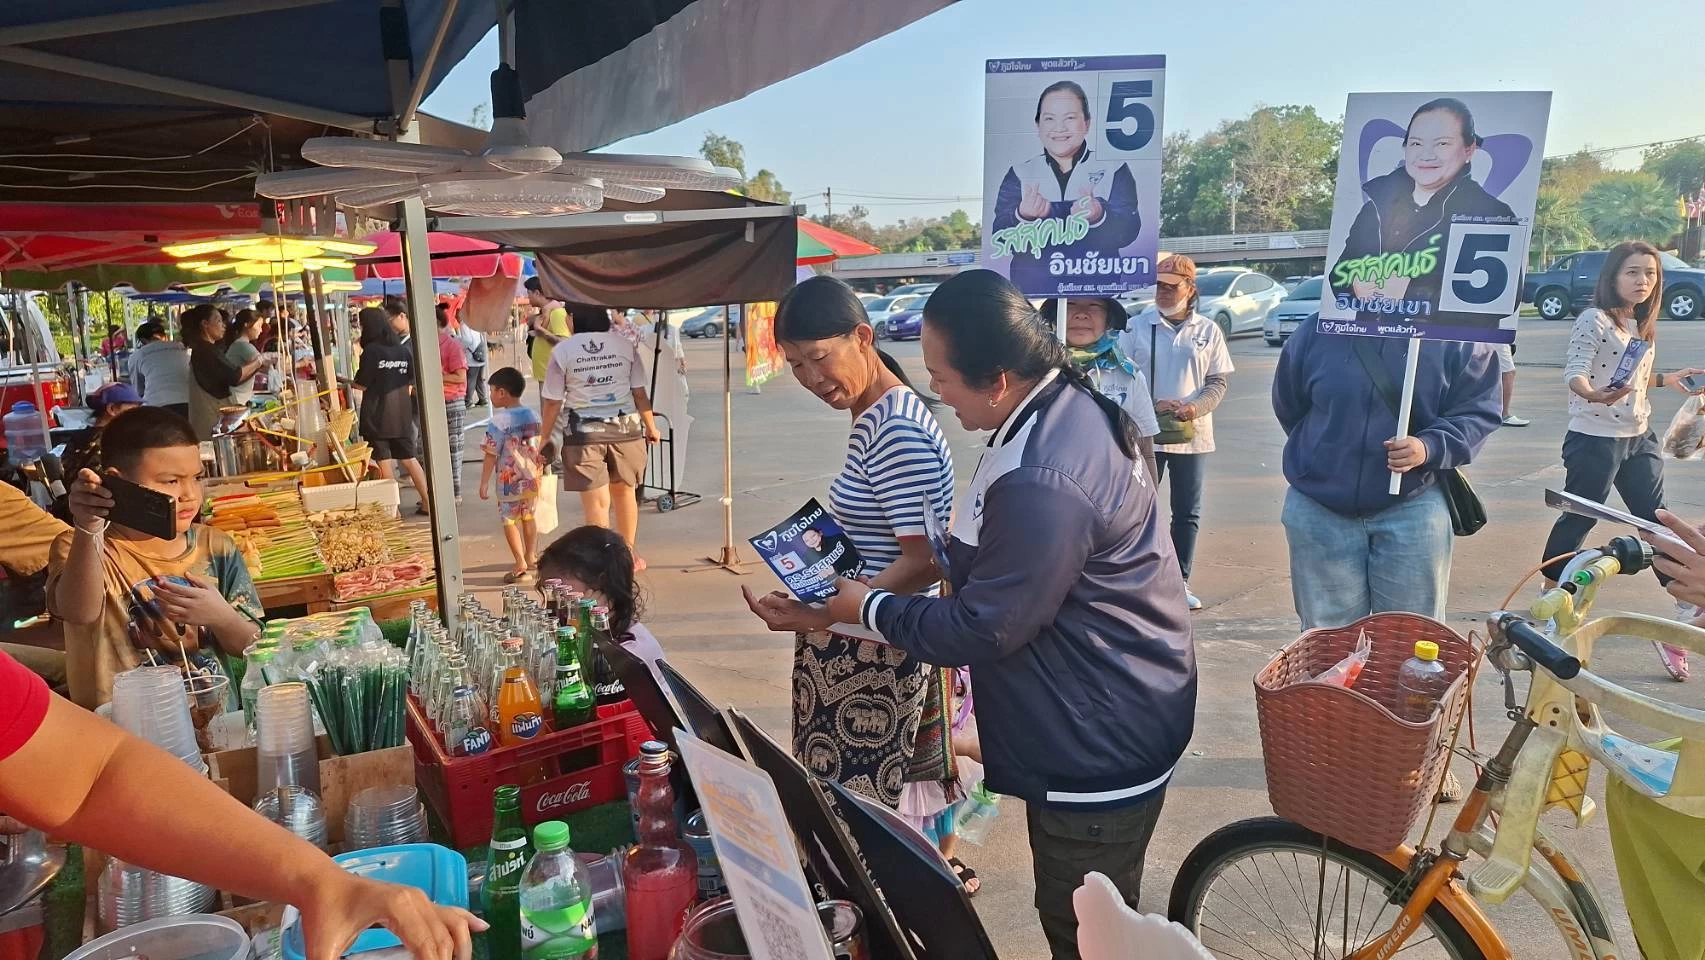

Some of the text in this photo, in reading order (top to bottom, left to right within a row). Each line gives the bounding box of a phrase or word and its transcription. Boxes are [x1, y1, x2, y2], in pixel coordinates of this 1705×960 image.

[1105, 79, 1154, 151] 5
[991, 196, 1090, 259] รสสุคนธ์
[1049, 251, 1149, 275] อินชัยเขา
[1332, 233, 1443, 289] รสสุคนธ์
[1451, 233, 1510, 305] 5
[1335, 292, 1431, 316] อินชัยเขา
[573, 362, 623, 374] minimarathon
[576, 354, 617, 364] Chattrakan
[778, 507, 823, 543] ภูมิใจไทย
[779, 557, 796, 570] 5
[463, 730, 490, 752] FANT
[537, 780, 592, 812] Coca-Cola
